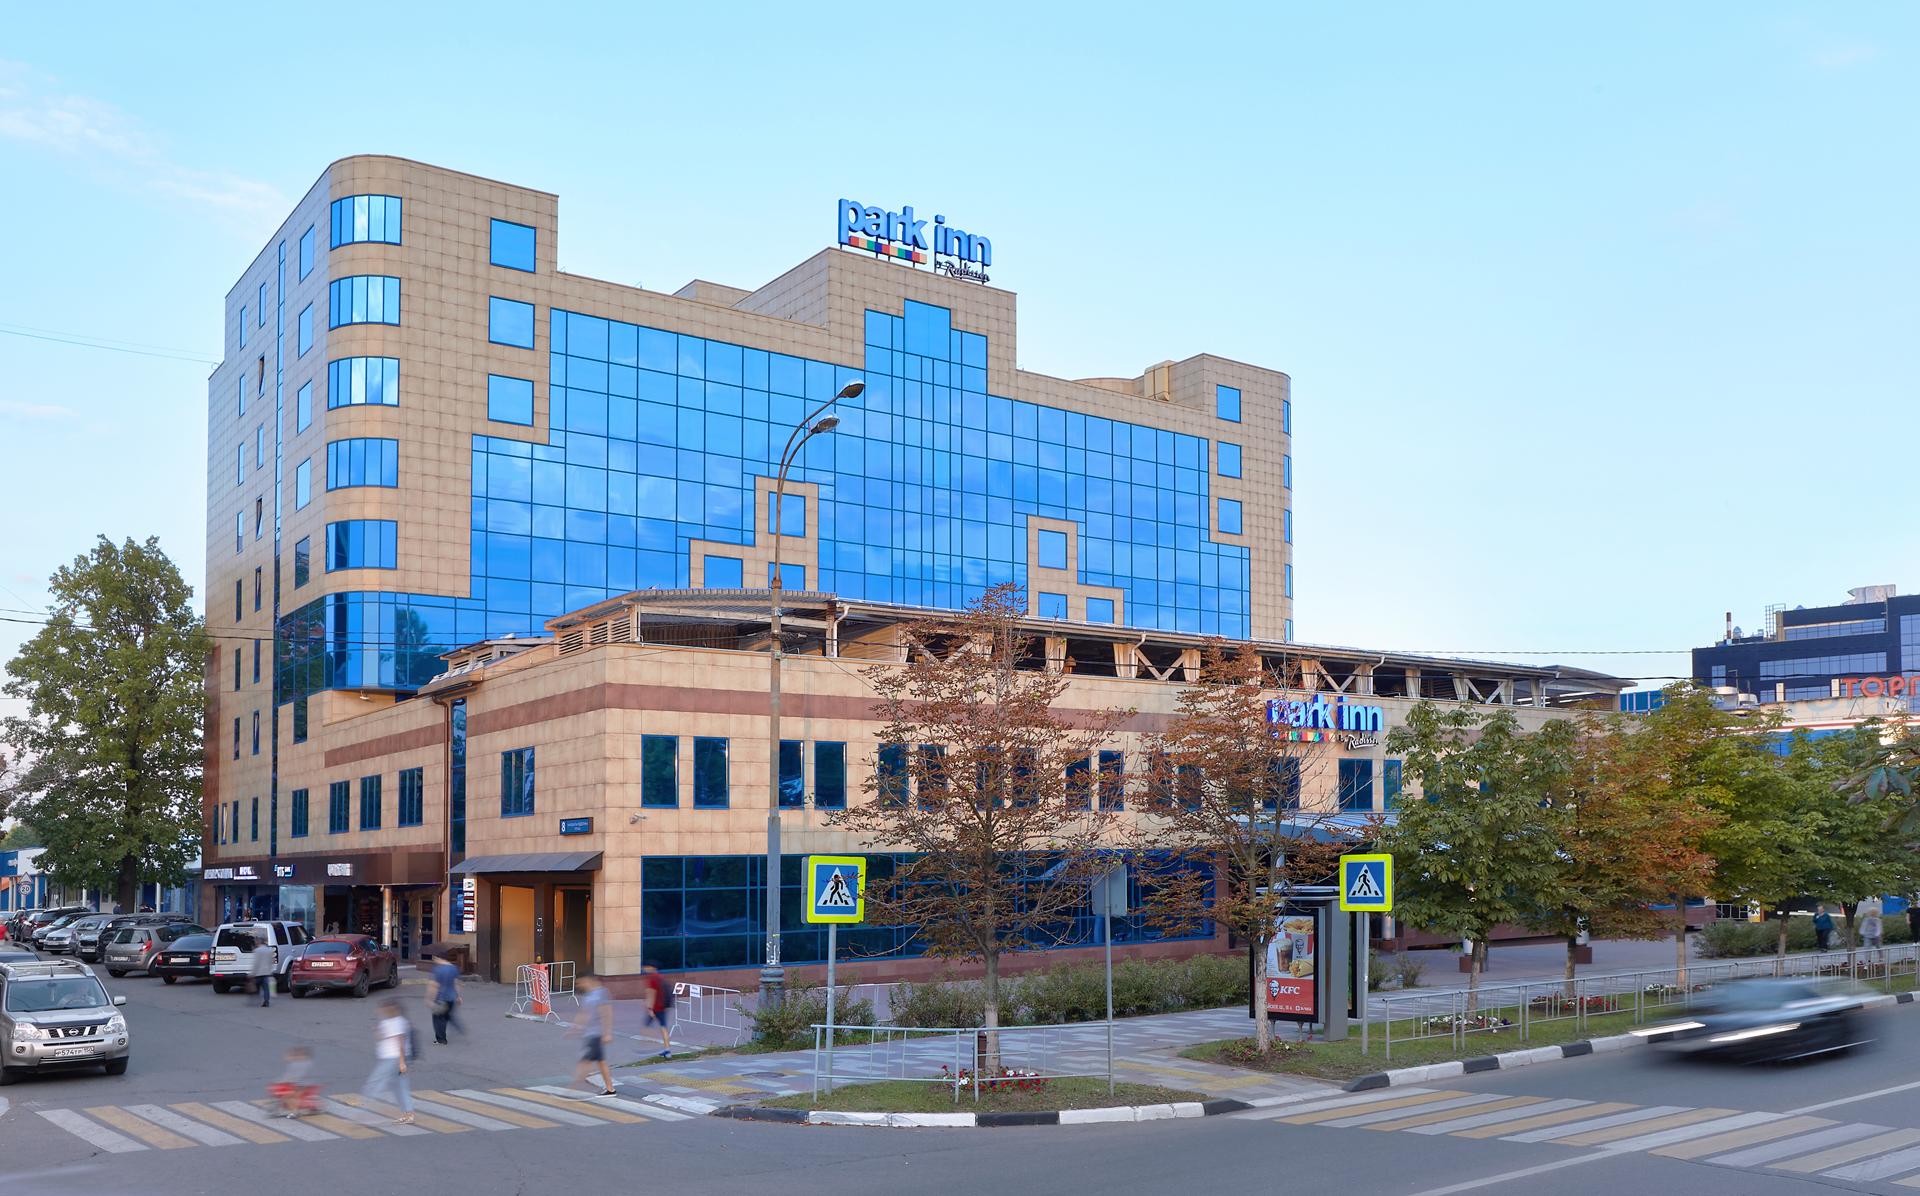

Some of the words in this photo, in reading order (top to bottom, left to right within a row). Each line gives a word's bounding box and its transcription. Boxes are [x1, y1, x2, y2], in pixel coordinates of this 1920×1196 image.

[838, 198, 928, 251] park
[934, 214, 992, 267] inn
[1337, 695, 1384, 731] inn
[561, 821, 566, 832] 8
[1280, 985, 1300, 995] KFC
